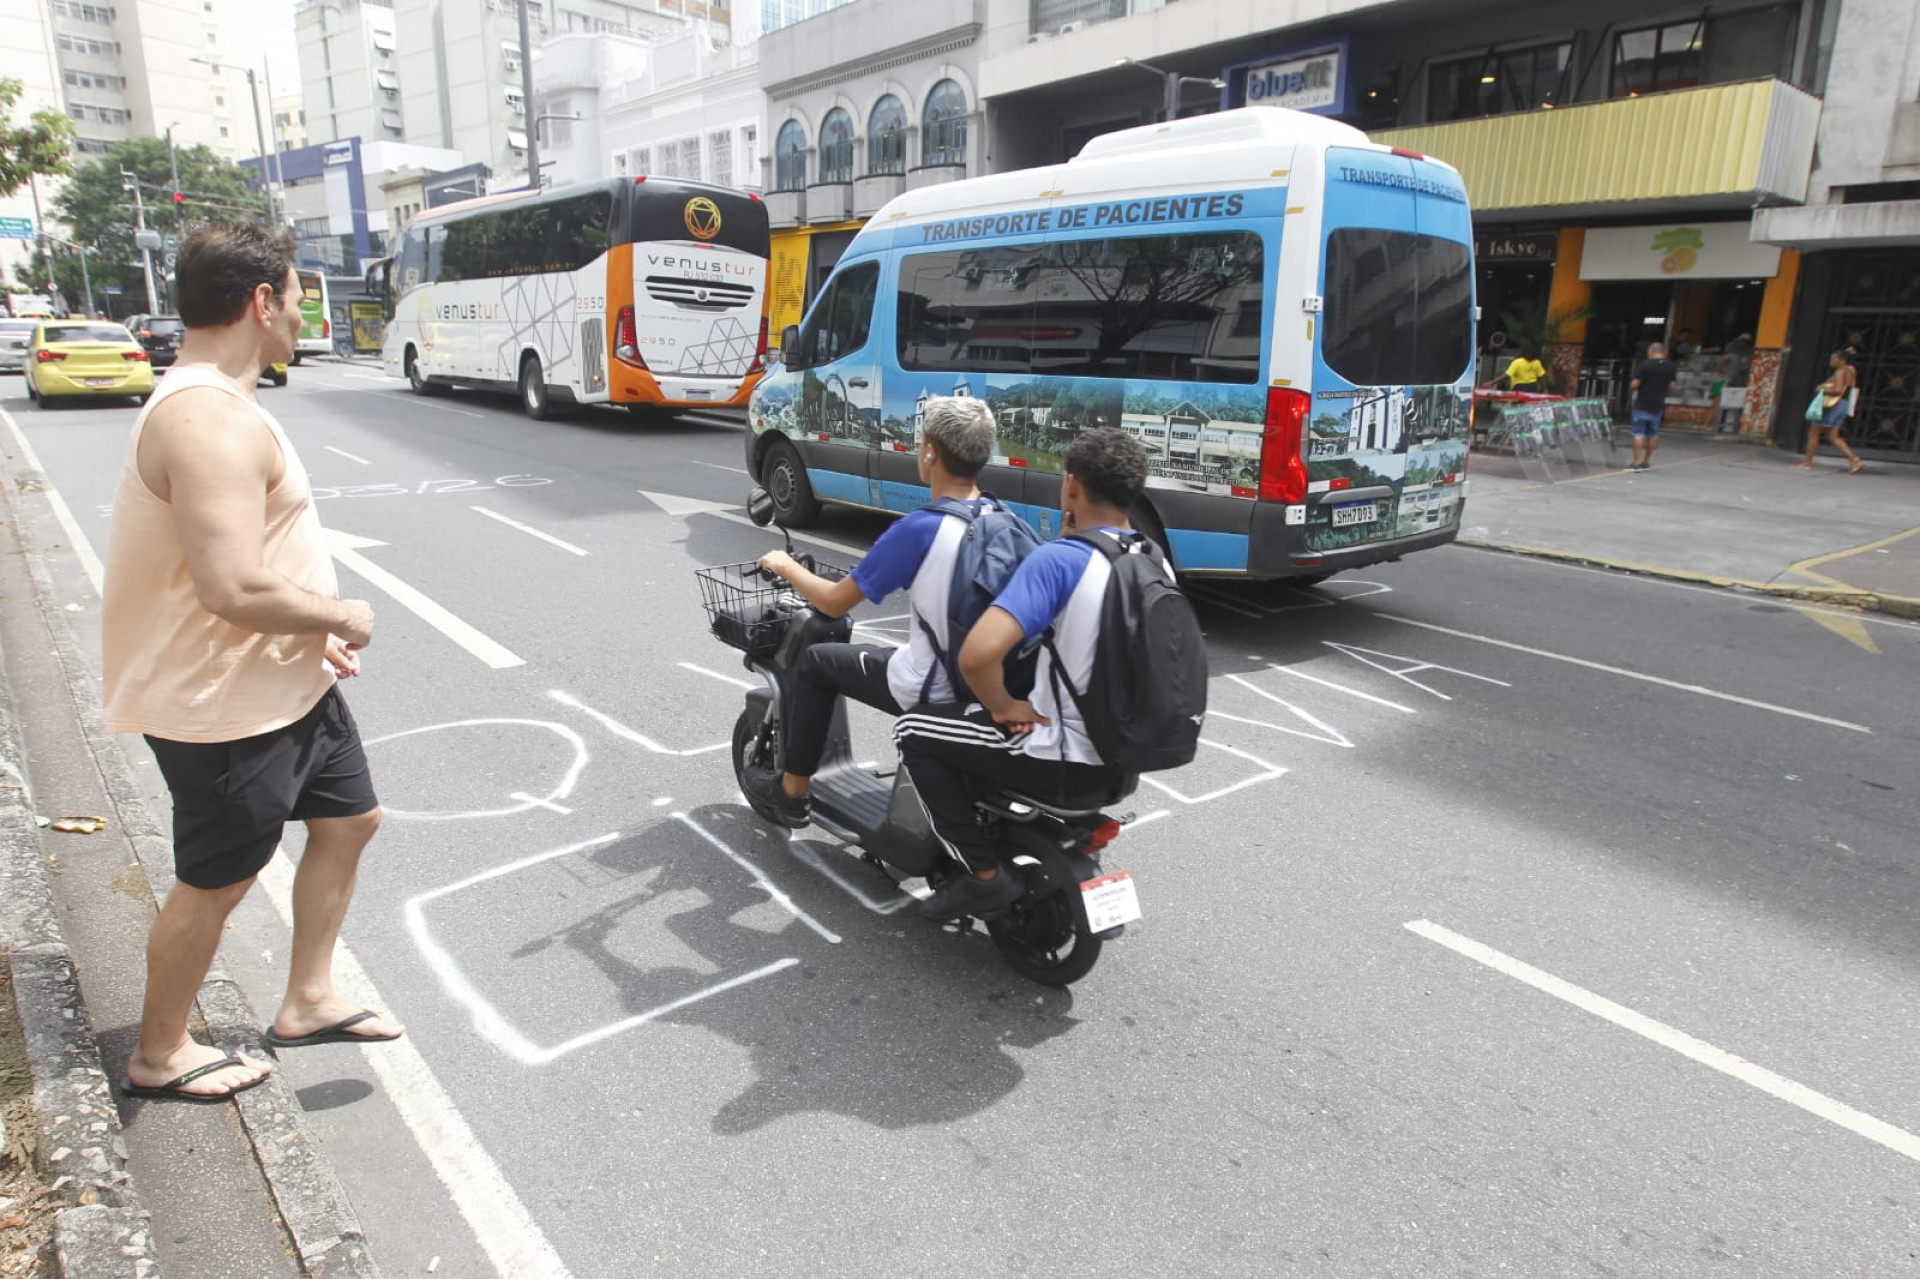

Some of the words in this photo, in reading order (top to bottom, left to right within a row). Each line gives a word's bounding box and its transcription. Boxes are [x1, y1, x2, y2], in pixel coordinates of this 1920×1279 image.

[1339, 167, 1417, 192] TRANSPORTE
[922, 210, 1051, 242] TRANSPORTE
[1057, 207, 1087, 229] DE
[1094, 193, 1245, 226] PACIENTES
[647, 253, 755, 277] venustur
[436, 301, 499, 320] venustur
